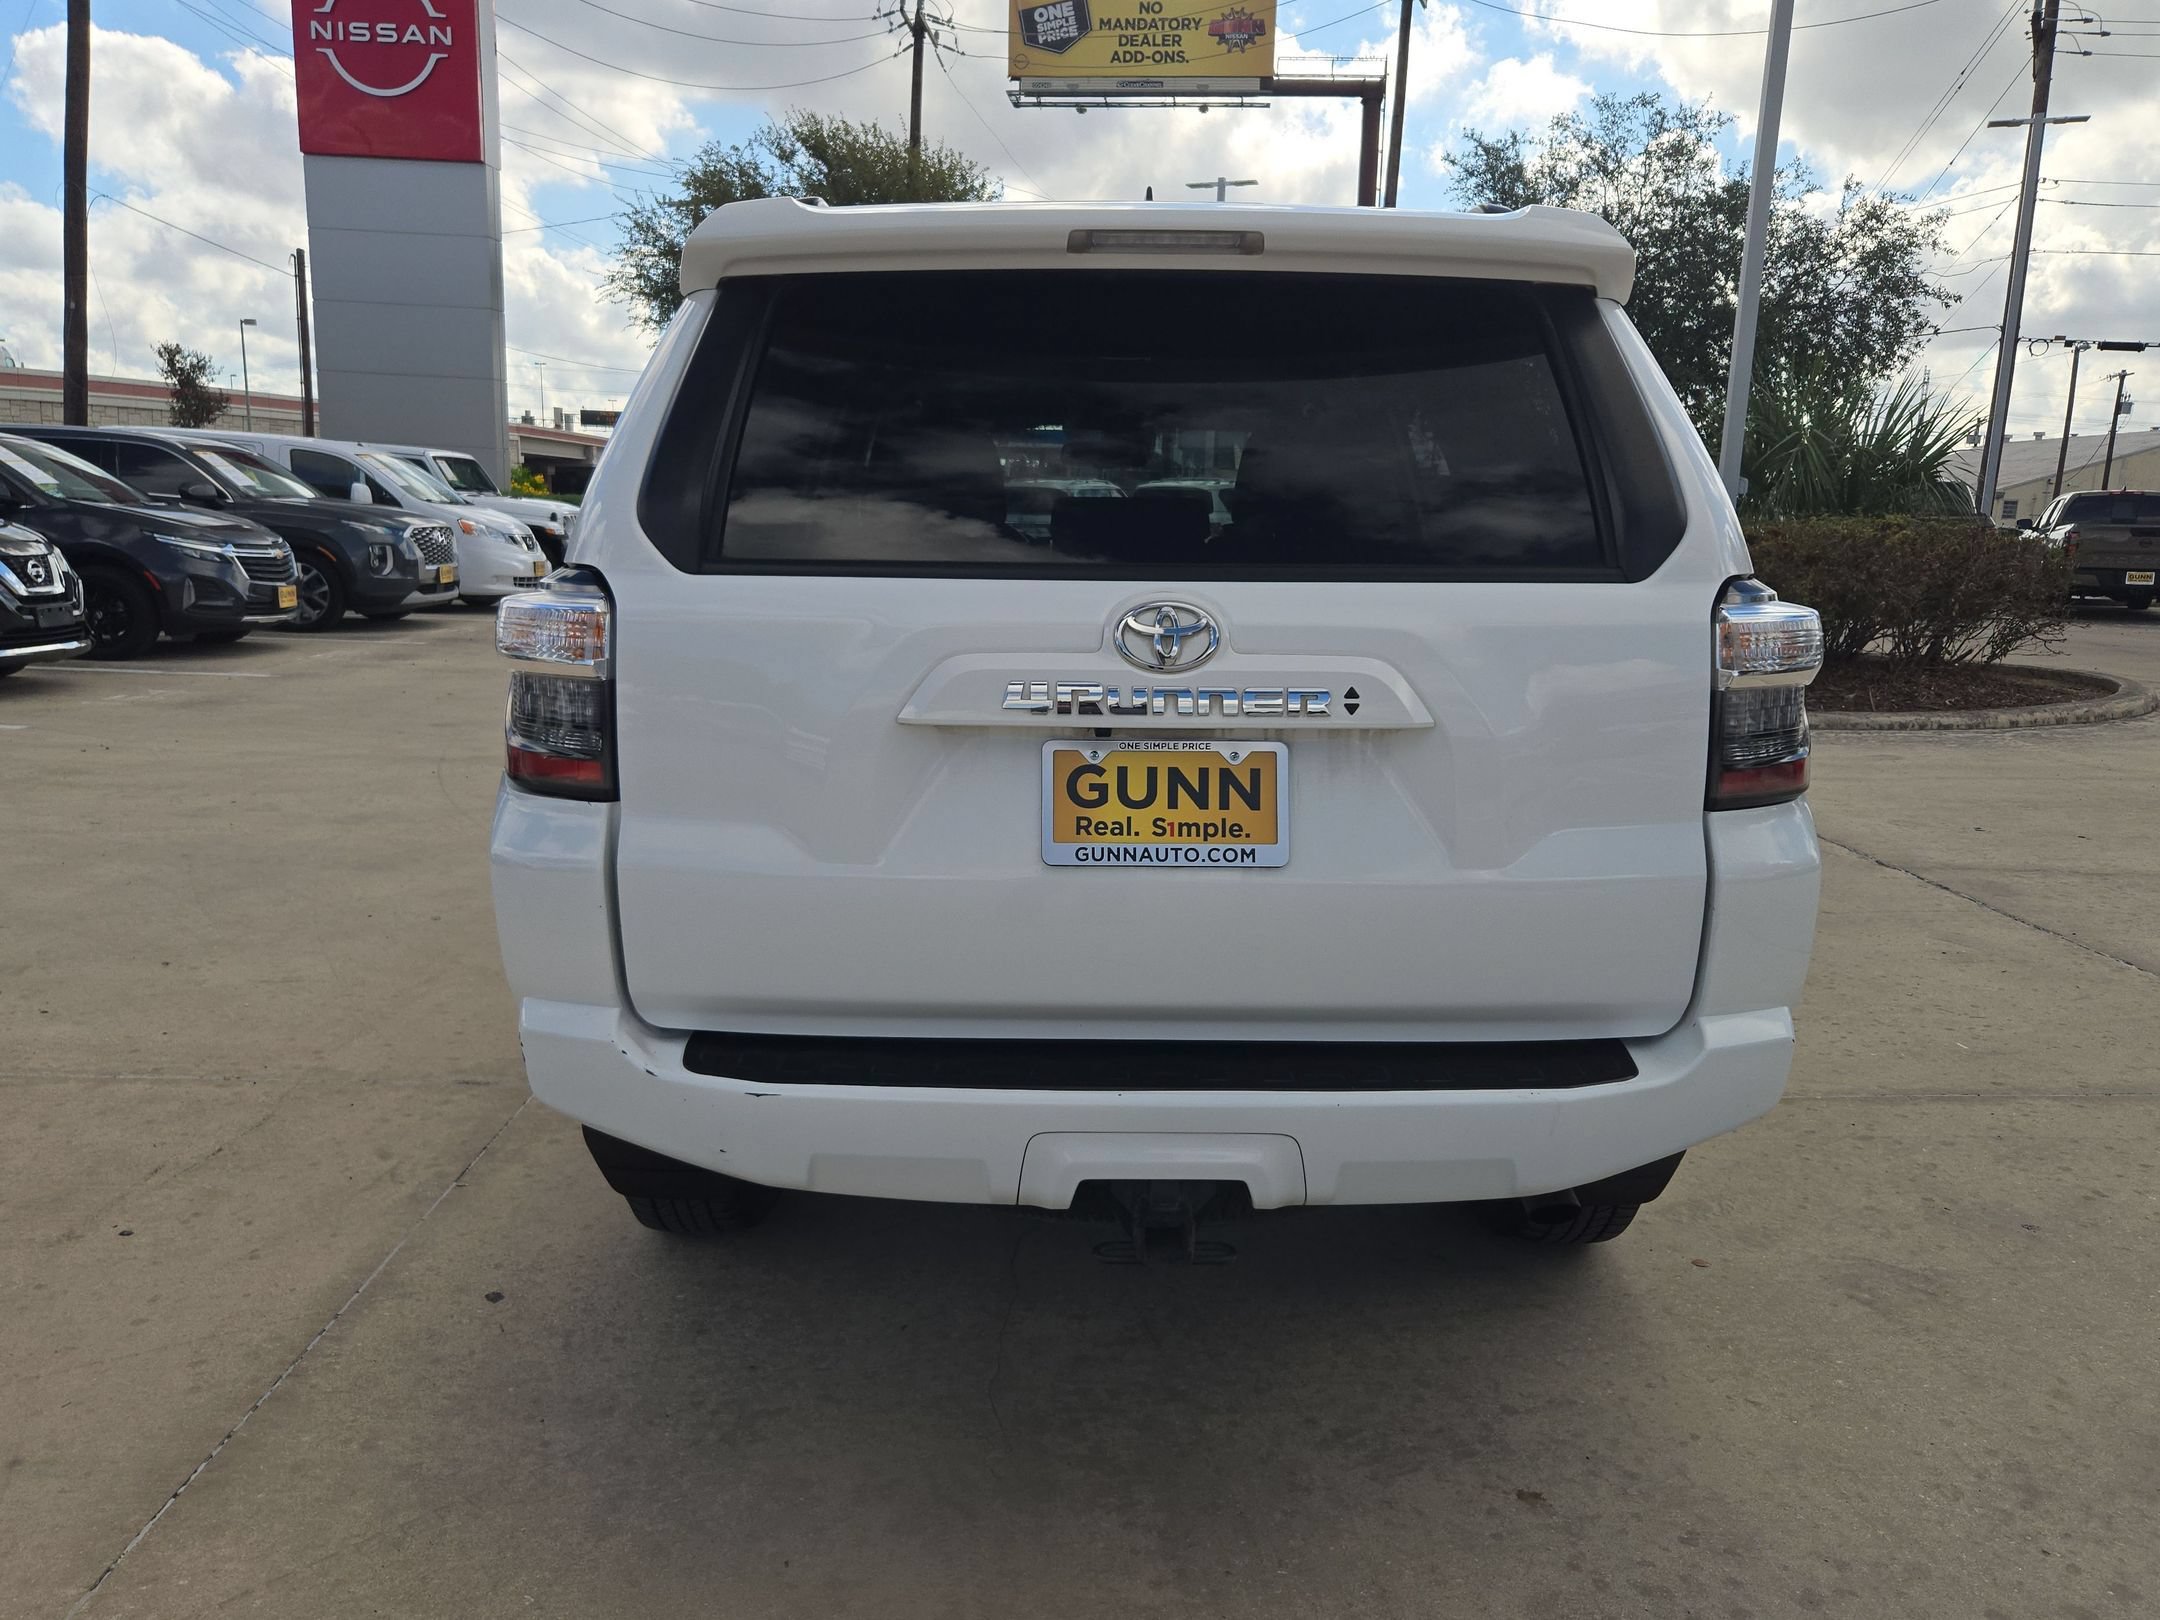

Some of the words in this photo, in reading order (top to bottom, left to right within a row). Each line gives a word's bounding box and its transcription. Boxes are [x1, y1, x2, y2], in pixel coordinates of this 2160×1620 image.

[1034, 1, 1075, 22] ONE
[1139, 1, 1163, 15] NO
[1037, 16, 1077, 32] SIMPLE
[1099, 17, 1202, 31] MANDATORY
[310, 20, 452, 46] NISSAN
[1038, 25, 1079, 44] PRICE
[1118, 34, 1182, 47] DEALER
[1110, 50, 1190, 63] ADD-ONS.
[1119, 742, 1141, 750] ONE
[1143, 742, 1180, 750] SIMPLE
[1182, 742, 1212, 751] PRICE
[1066, 763, 1261, 811] GUNN
[1075, 816, 1140, 837] Real.
[1075, 847, 1256, 863] GUNNAUTO.COM
